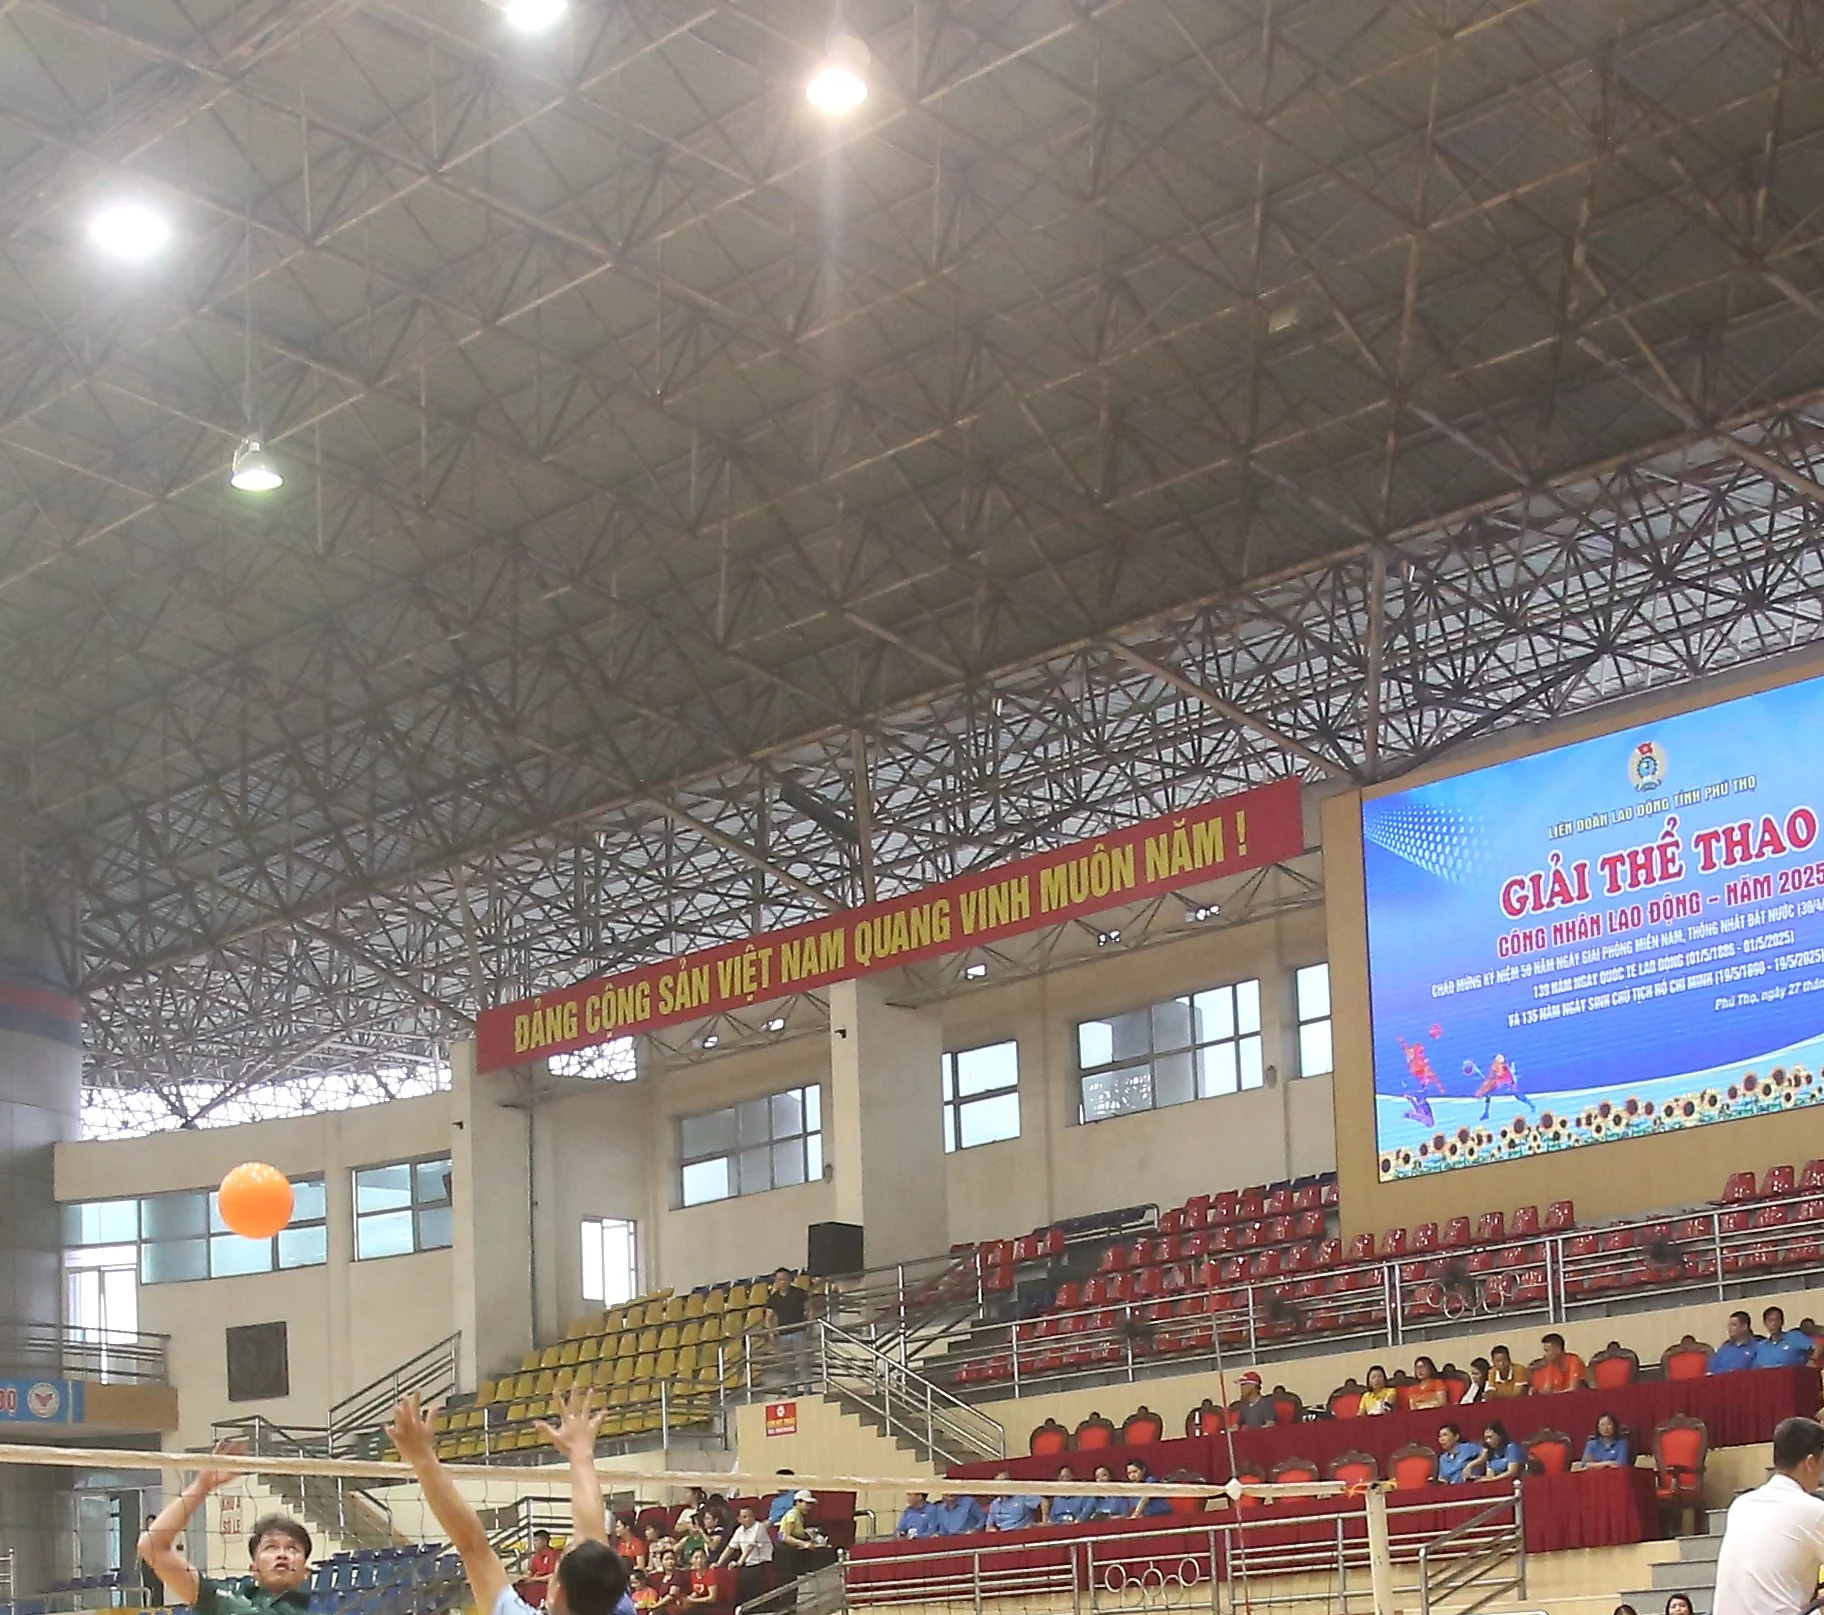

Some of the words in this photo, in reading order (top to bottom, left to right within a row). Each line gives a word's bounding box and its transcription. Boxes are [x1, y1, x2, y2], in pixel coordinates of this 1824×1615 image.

[1611, 807, 1633, 825] LAO
[1500, 851, 1592, 918] GIẢI
[1599, 815, 1684, 895] THỂ
[1694, 808, 1818, 872] THAO
[514, 997, 578, 1053] ĐẢNG
[585, 981, 651, 1038] CỘNG
[658, 957, 711, 1016] SẢN
[717, 944, 773, 1002] VIỆT
[780, 927, 846, 983] NAM
[854, 898, 951, 968] QUANG
[959, 875, 1031, 935] VINH
[1039, 842, 1135, 914] MUÔN
[1144, 816, 1225, 883] NĂM
[1498, 927, 1546, 958] CÔNG
[1552, 913, 1602, 945] NHÂN
[1608, 905, 1642, 934] LAO
[1649, 891, 1701, 925] ĐỘNG
[1726, 874, 1773, 907] NĂM
[1788, 982, 1802, 996] 27
